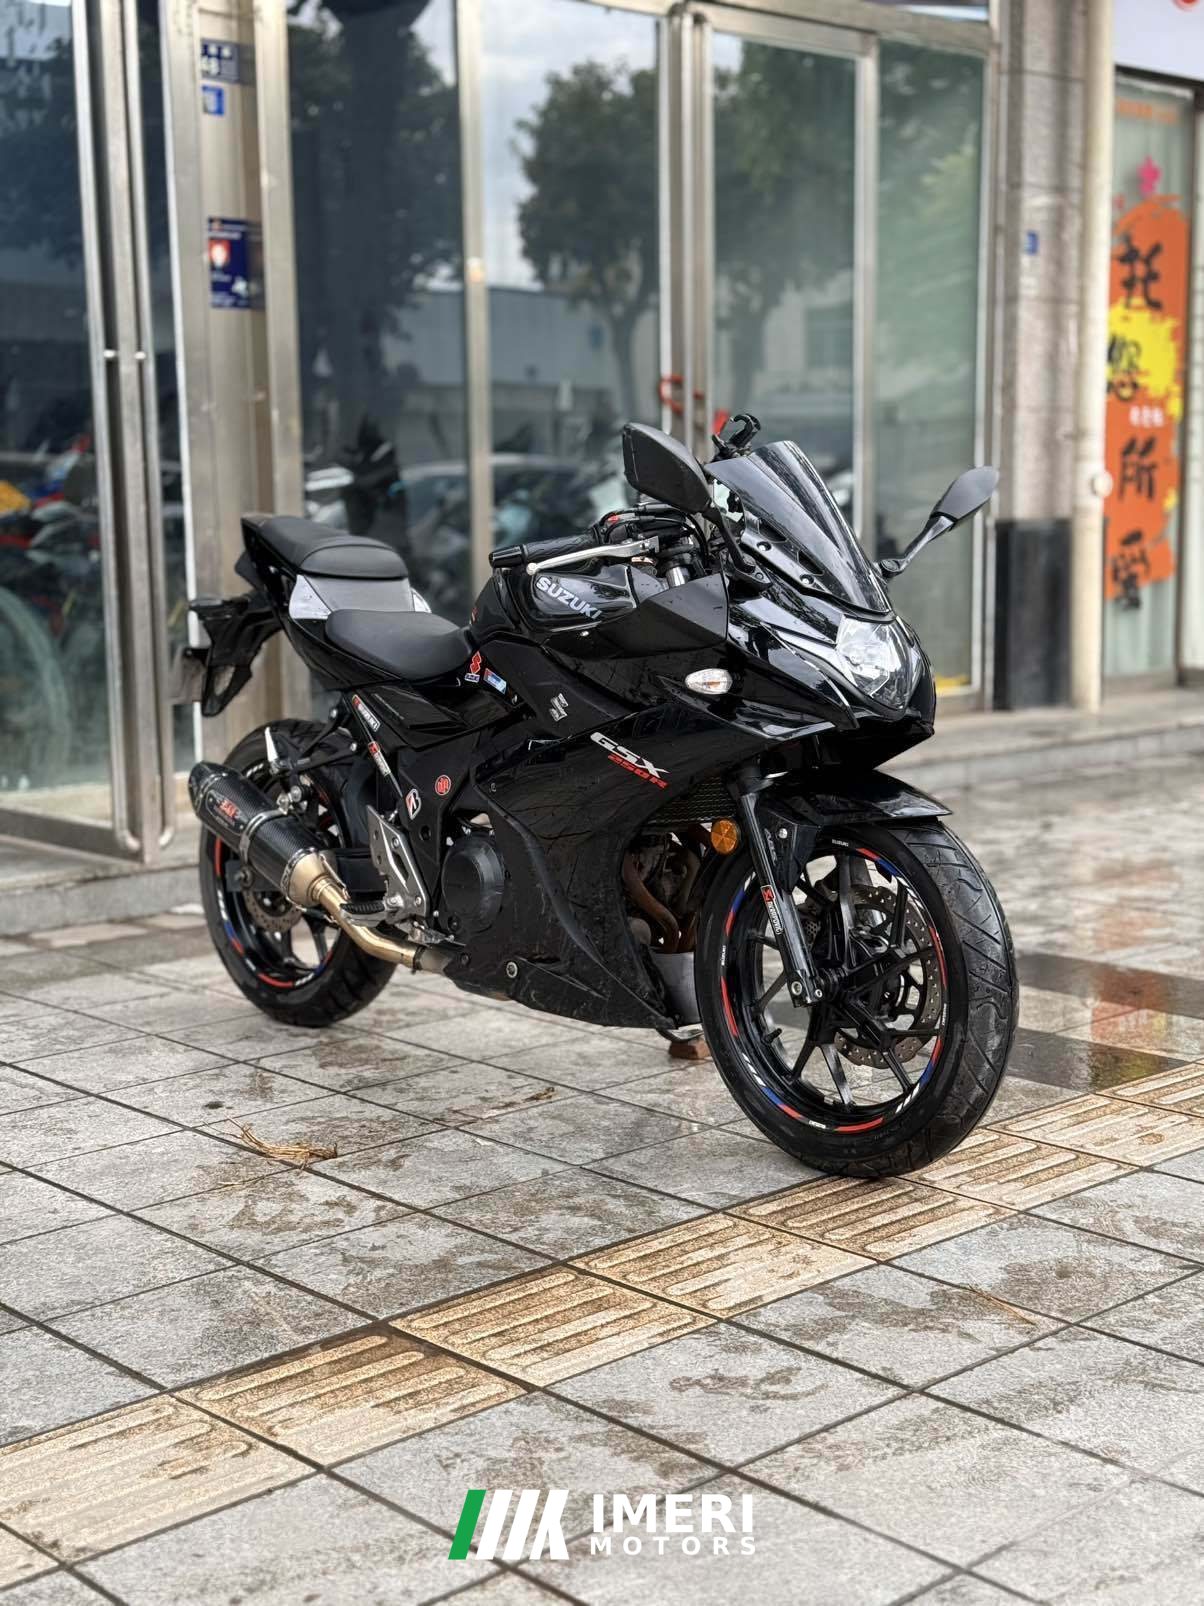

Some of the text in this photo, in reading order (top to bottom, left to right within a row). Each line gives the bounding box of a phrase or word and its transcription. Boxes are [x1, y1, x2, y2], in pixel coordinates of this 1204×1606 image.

[536, 576, 602, 619] SUZUKI
[590, 732, 670, 778] GSX
[607, 754, 668, 789] 250R
